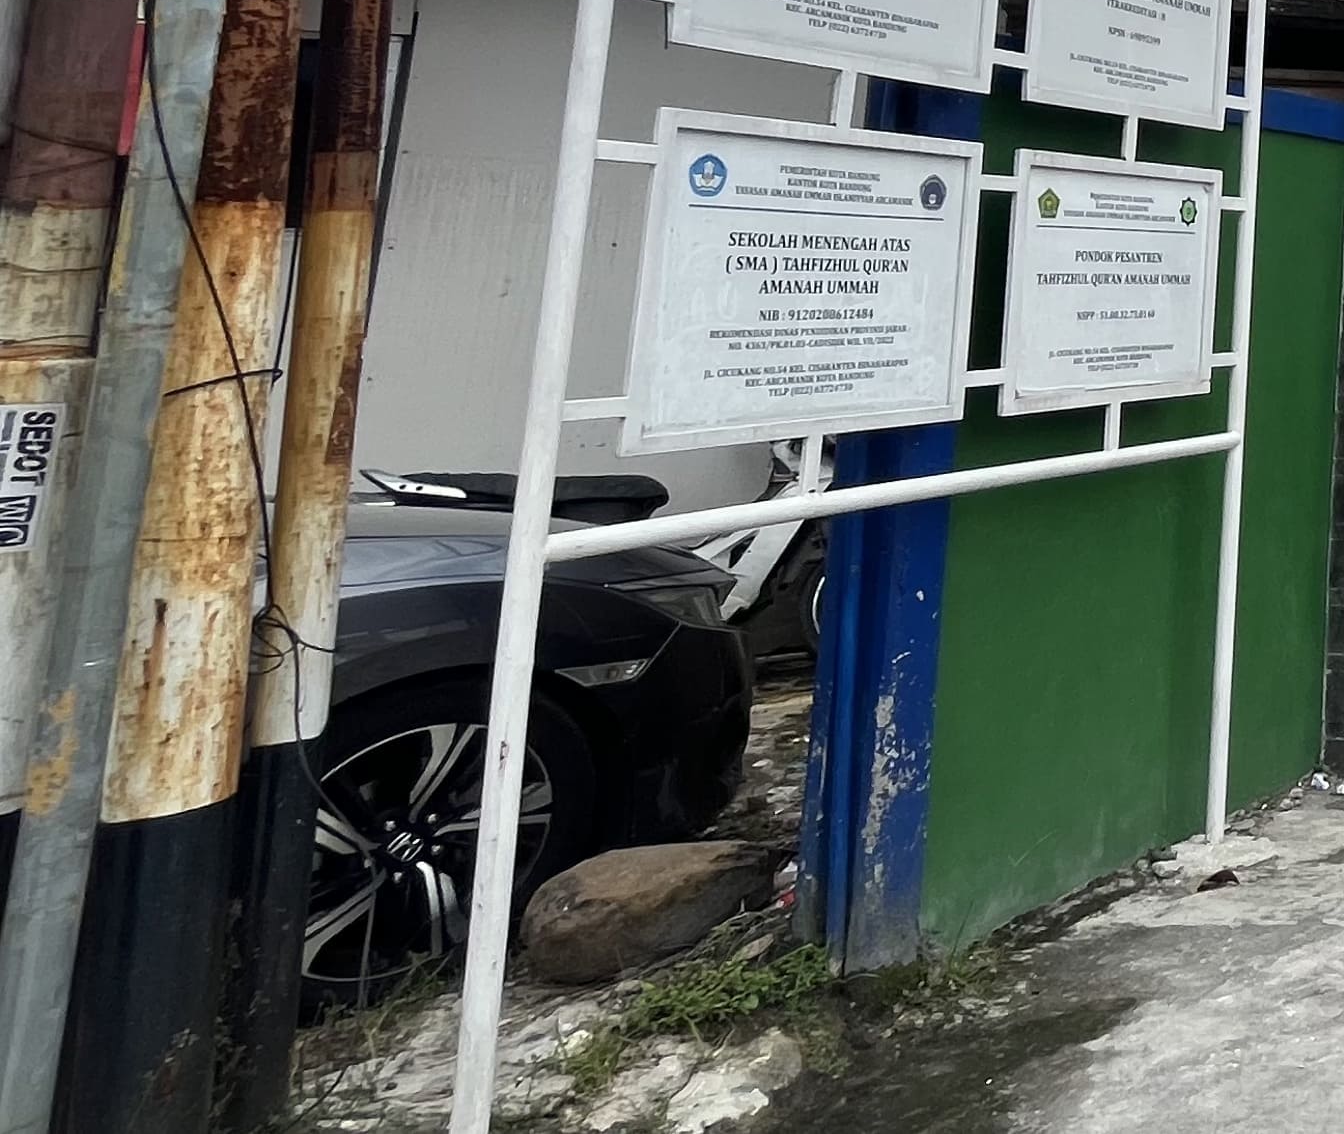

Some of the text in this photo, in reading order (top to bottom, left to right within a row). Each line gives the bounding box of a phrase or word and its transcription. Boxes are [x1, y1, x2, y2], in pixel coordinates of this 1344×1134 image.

[728, 232, 911, 252] SEKOLAH MENENGAH ATAS
[1076, 251, 1162, 263] PONDOK PESANTREN
[782, 257, 859, 272] TAHFIZHUL
[863, 259, 909, 275] QUR'AN
[1037, 274, 1088, 285] TAHFIZHUL
[1124, 274, 1159, 284] AMANAH
[1161, 275, 1191, 284] UMMAH
[759, 280, 879, 294] AMANAH UMMAH
[759, 310, 779, 321] NIB
[10, 411, 56, 486] SEDOT
